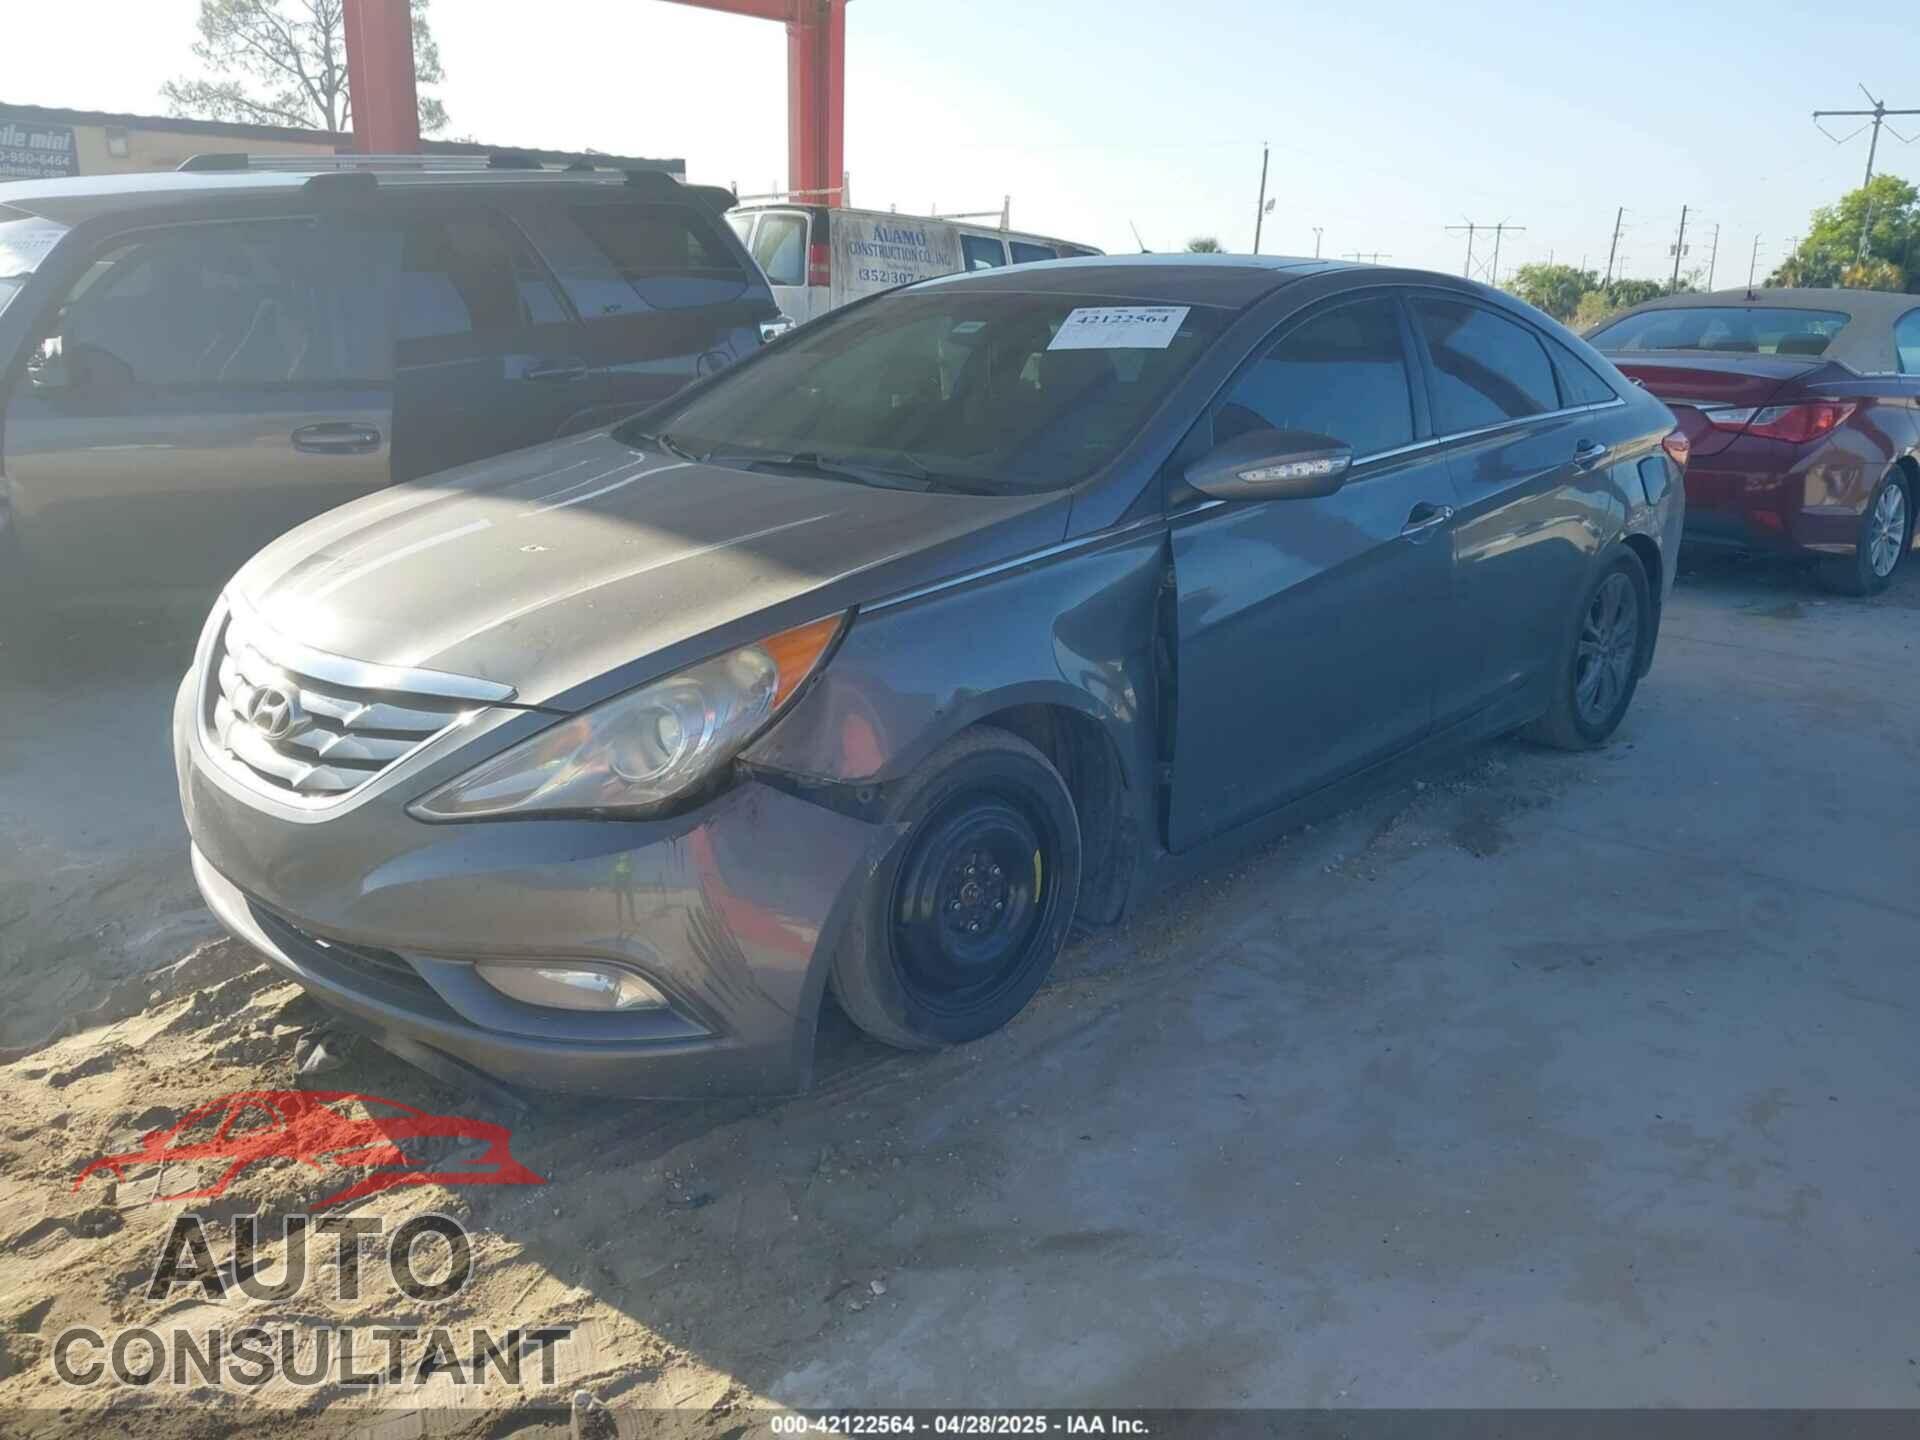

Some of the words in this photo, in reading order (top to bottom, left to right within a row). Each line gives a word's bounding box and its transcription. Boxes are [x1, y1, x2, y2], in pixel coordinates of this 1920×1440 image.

[29, 130, 72, 151] mini
[873, 224, 926, 246] ALAMO
[848, 240, 918, 262] CONSTRUCTION
